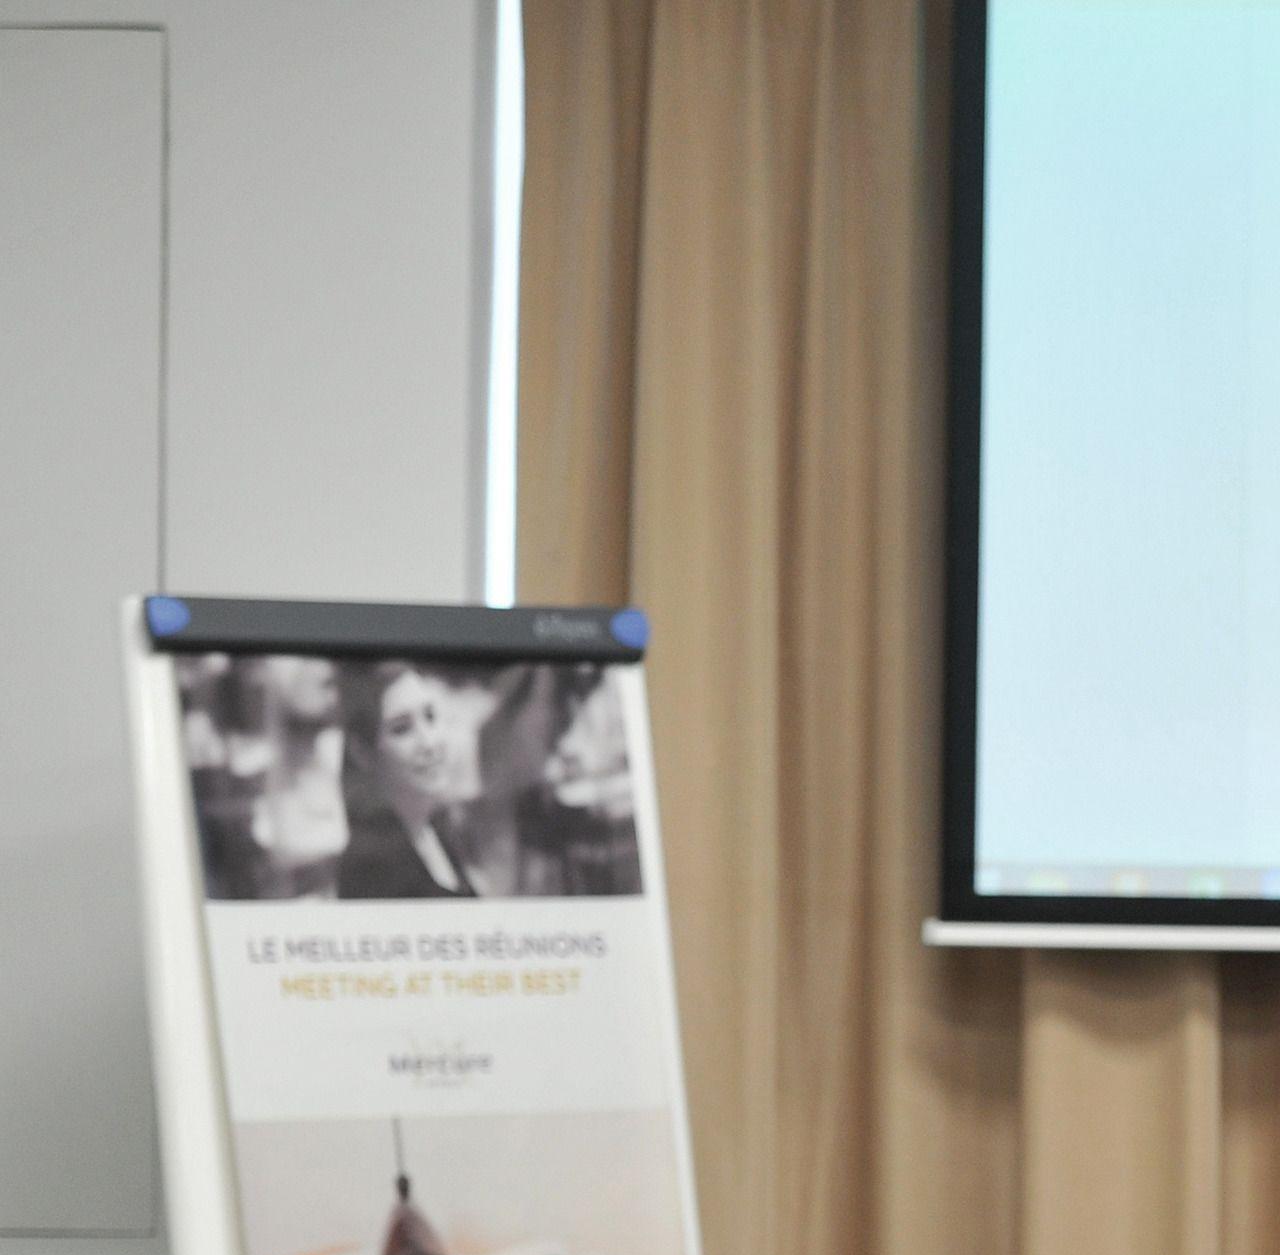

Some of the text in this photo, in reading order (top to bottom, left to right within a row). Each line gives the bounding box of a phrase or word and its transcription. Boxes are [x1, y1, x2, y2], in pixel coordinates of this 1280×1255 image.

[247, 923, 608, 964] LE MEILLEUR DES RÉUNIONS
[280, 966, 584, 1000] MEETING AT THEIR BEST
